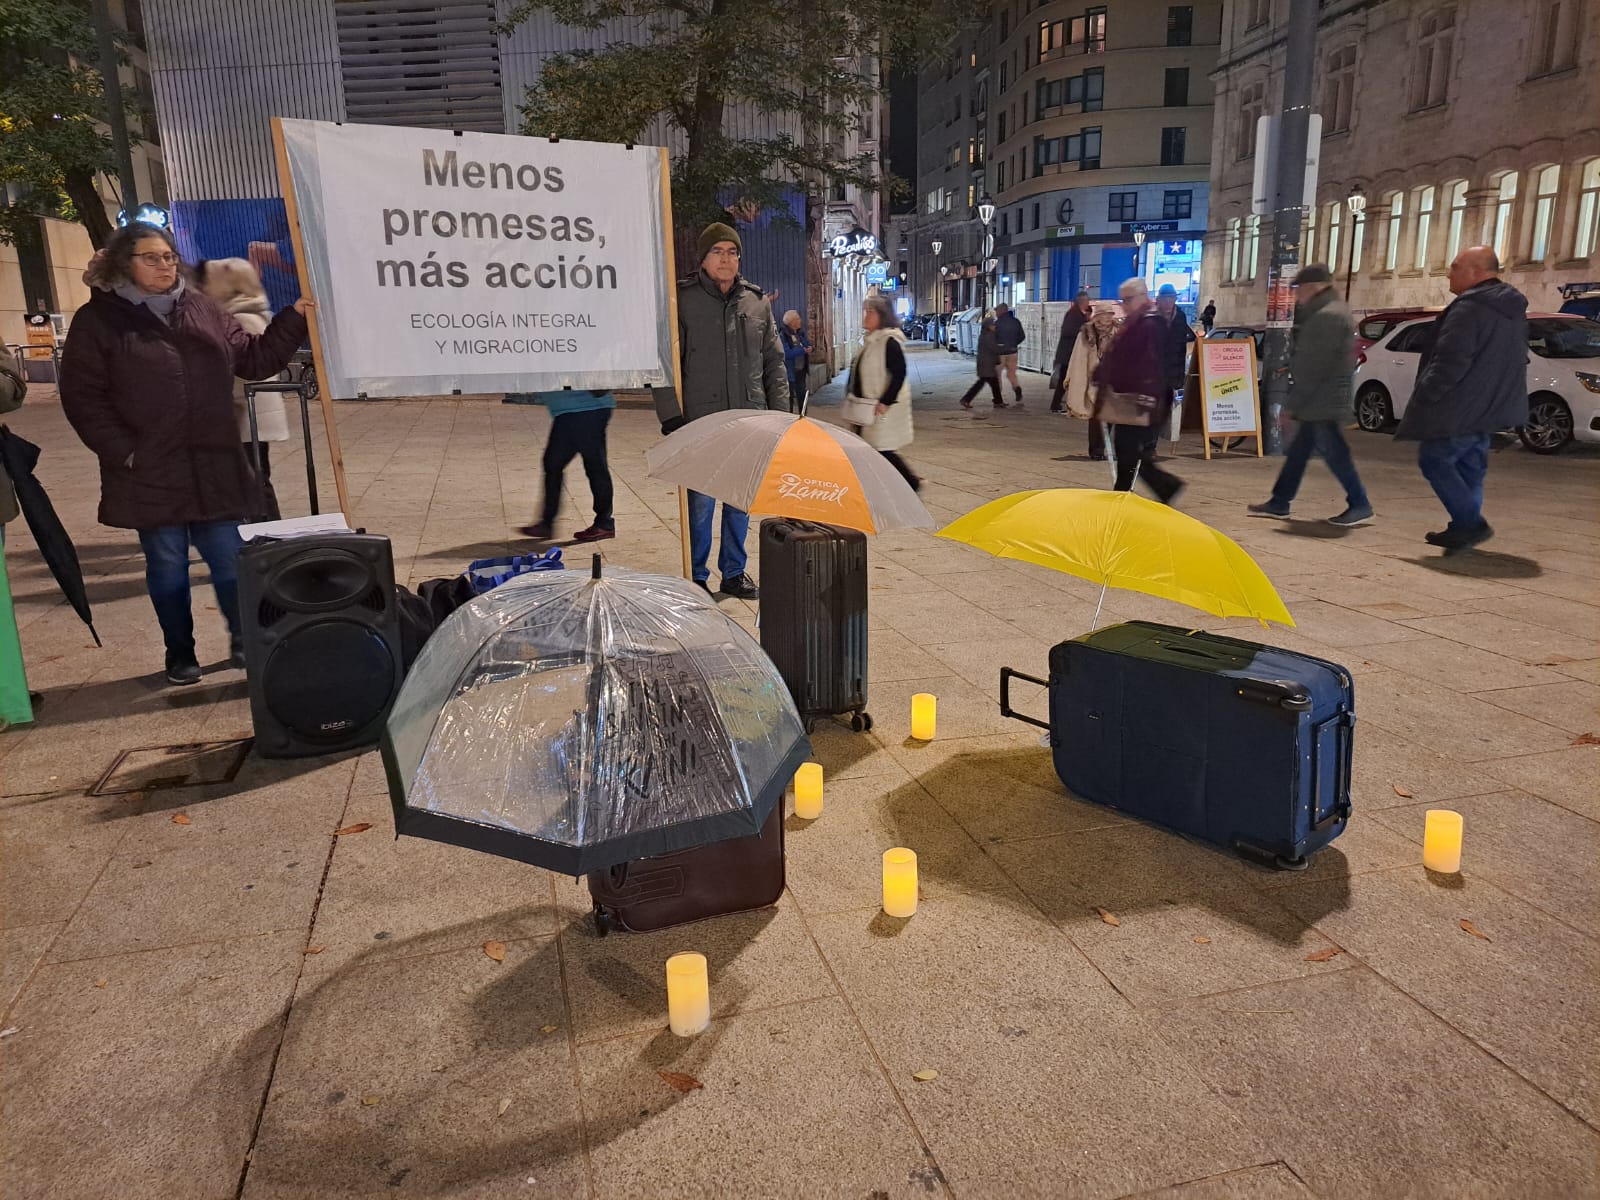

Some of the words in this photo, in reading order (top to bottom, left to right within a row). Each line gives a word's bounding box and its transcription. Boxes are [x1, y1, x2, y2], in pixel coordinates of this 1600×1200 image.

[422, 149, 565, 193] Menos
[382, 207, 606, 248] promesas,
[376, 251, 470, 288] más
[485, 255, 617, 289] acción
[410, 310, 507, 330] ECOLOGÍA
[512, 312, 597, 329] INTEGRAL
[435, 340, 447, 355] Y
[453, 338, 578, 354] MIGRACIONES
